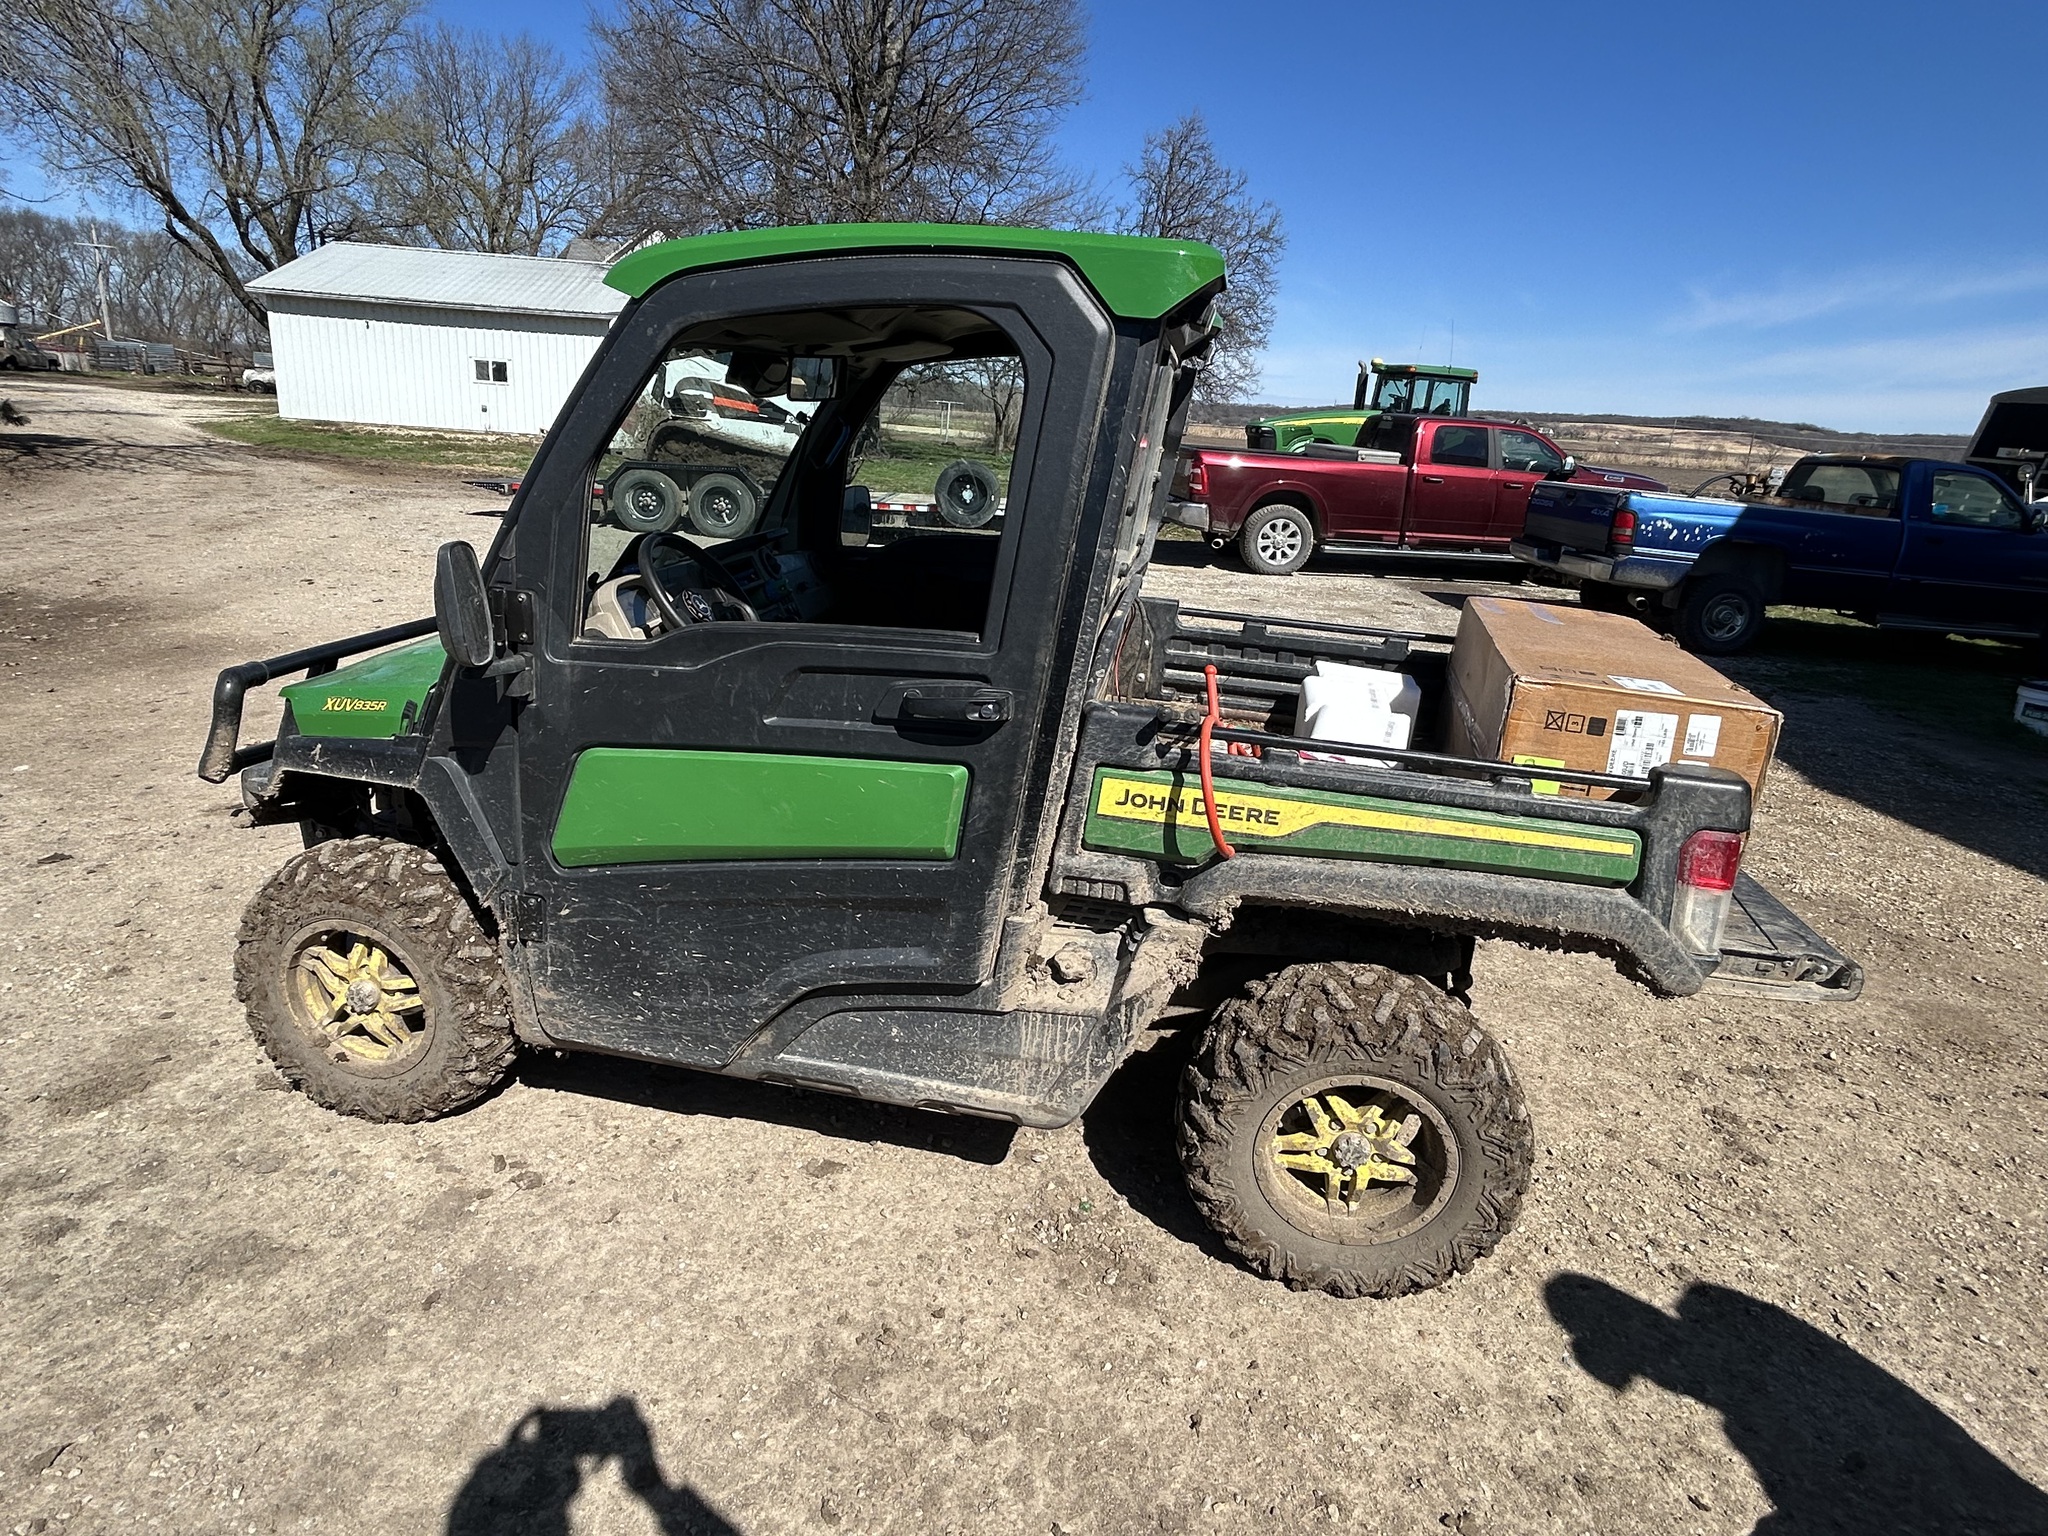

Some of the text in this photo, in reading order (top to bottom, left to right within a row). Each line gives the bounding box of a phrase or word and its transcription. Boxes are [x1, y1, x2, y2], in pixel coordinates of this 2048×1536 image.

[321, 697, 388, 711] XUV835R
[1115, 788, 1281, 826] JOHN DEERE
